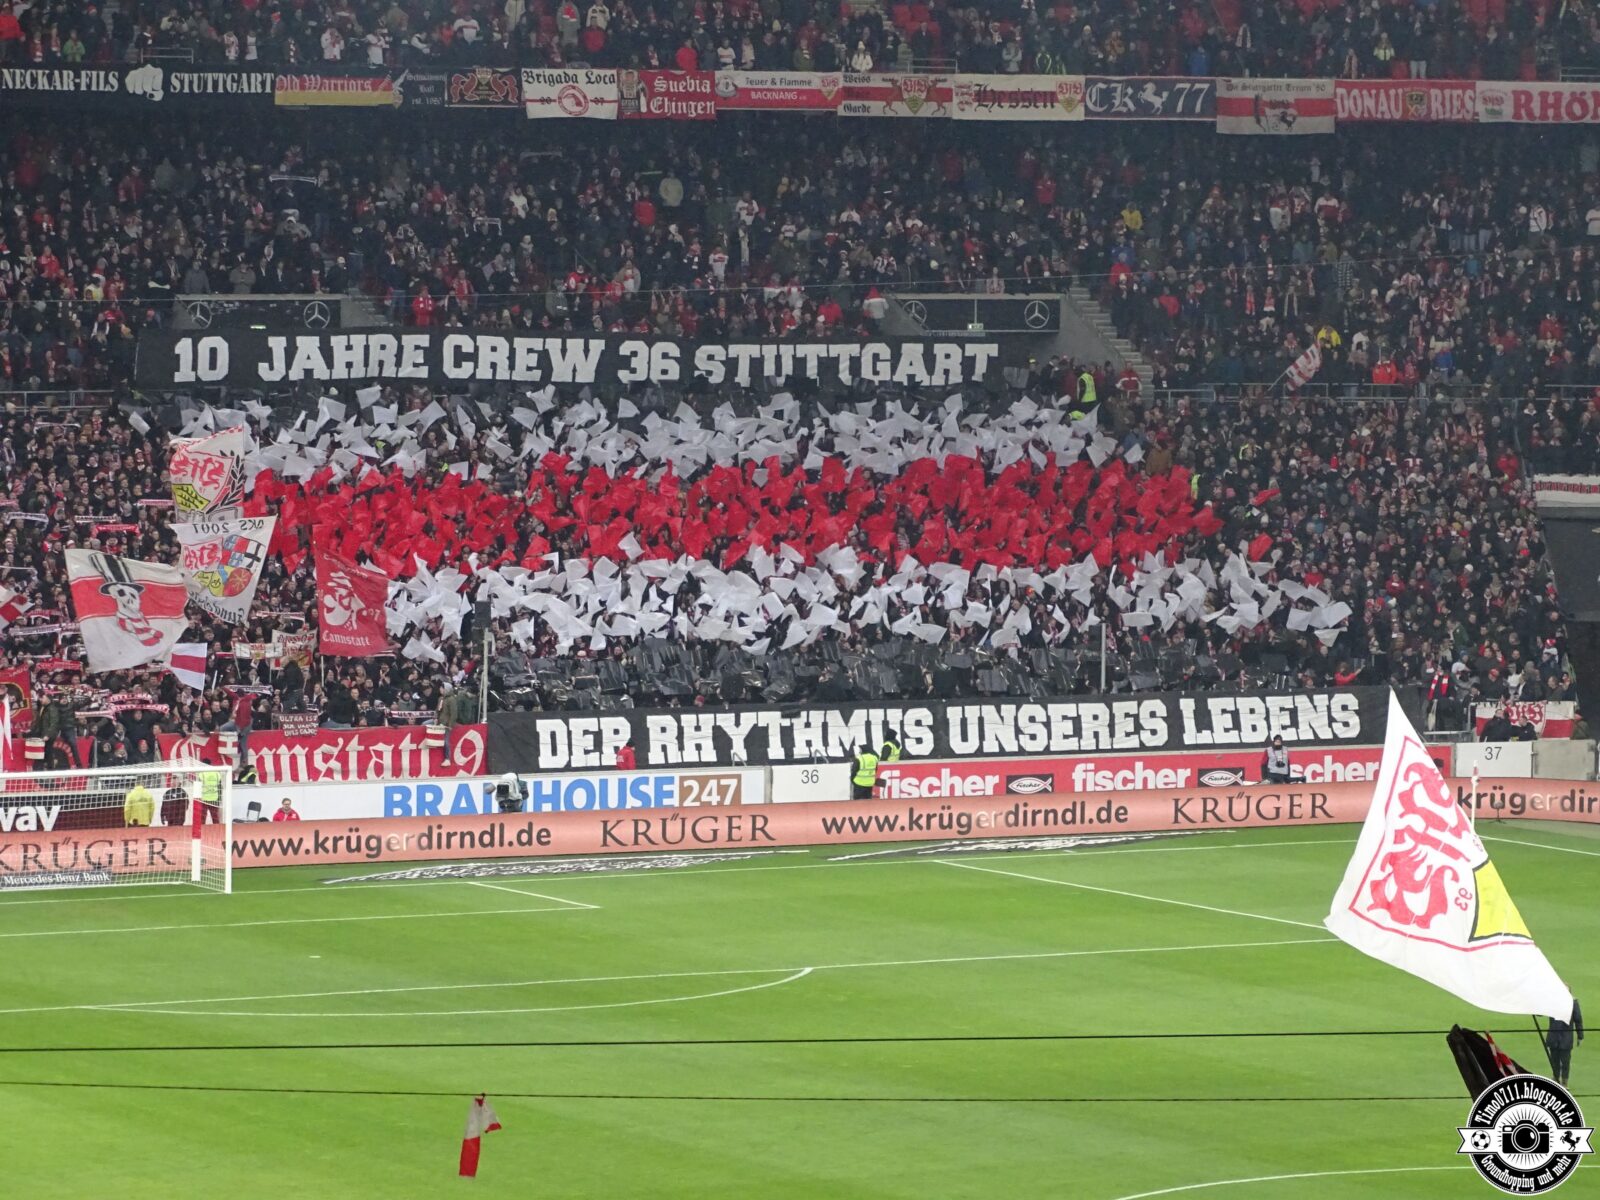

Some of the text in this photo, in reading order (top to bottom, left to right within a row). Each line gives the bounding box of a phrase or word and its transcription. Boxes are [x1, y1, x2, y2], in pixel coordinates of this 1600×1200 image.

[1, 68, 275, 93] NECKAR-FILS STUTTGART
[275, 73, 372, 93] Old Warriors
[523, 70, 616, 88] Brigada Loca
[654, 76, 711, 93] Suebia
[779, 77, 812, 87] Flamme
[750, 91, 798, 100] BACKNANG
[1173, 83, 1209, 113] 77
[1335, 87, 1476, 121] DONAU RIES
[174, 334, 998, 387] 10 JAHRE CREW 36 STUTTGART
[322, 629, 371, 646] Cannstatt
[536, 693, 1361, 769] DER RHYTHMUS UNSERES LEBENS
[170, 731, 437, 784] Cnnstatt
[1484, 747, 1502, 760] 37
[800, 769, 819, 784] 36
[879, 768, 1000, 799] fischer
[1072, 761, 1191, 792] fischer
[1289, 755, 1379, 784] scher
[384, 775, 739, 818] BRAIHOUSE 247
[1457, 785, 1600, 816] krügerdir
[221, 791, 1334, 859] www.krügerdirndl.de KRÜGER www.krügerdirndl.de KRÜGER
[4, 872, 110, 886] Mercedes-Benz Bank
